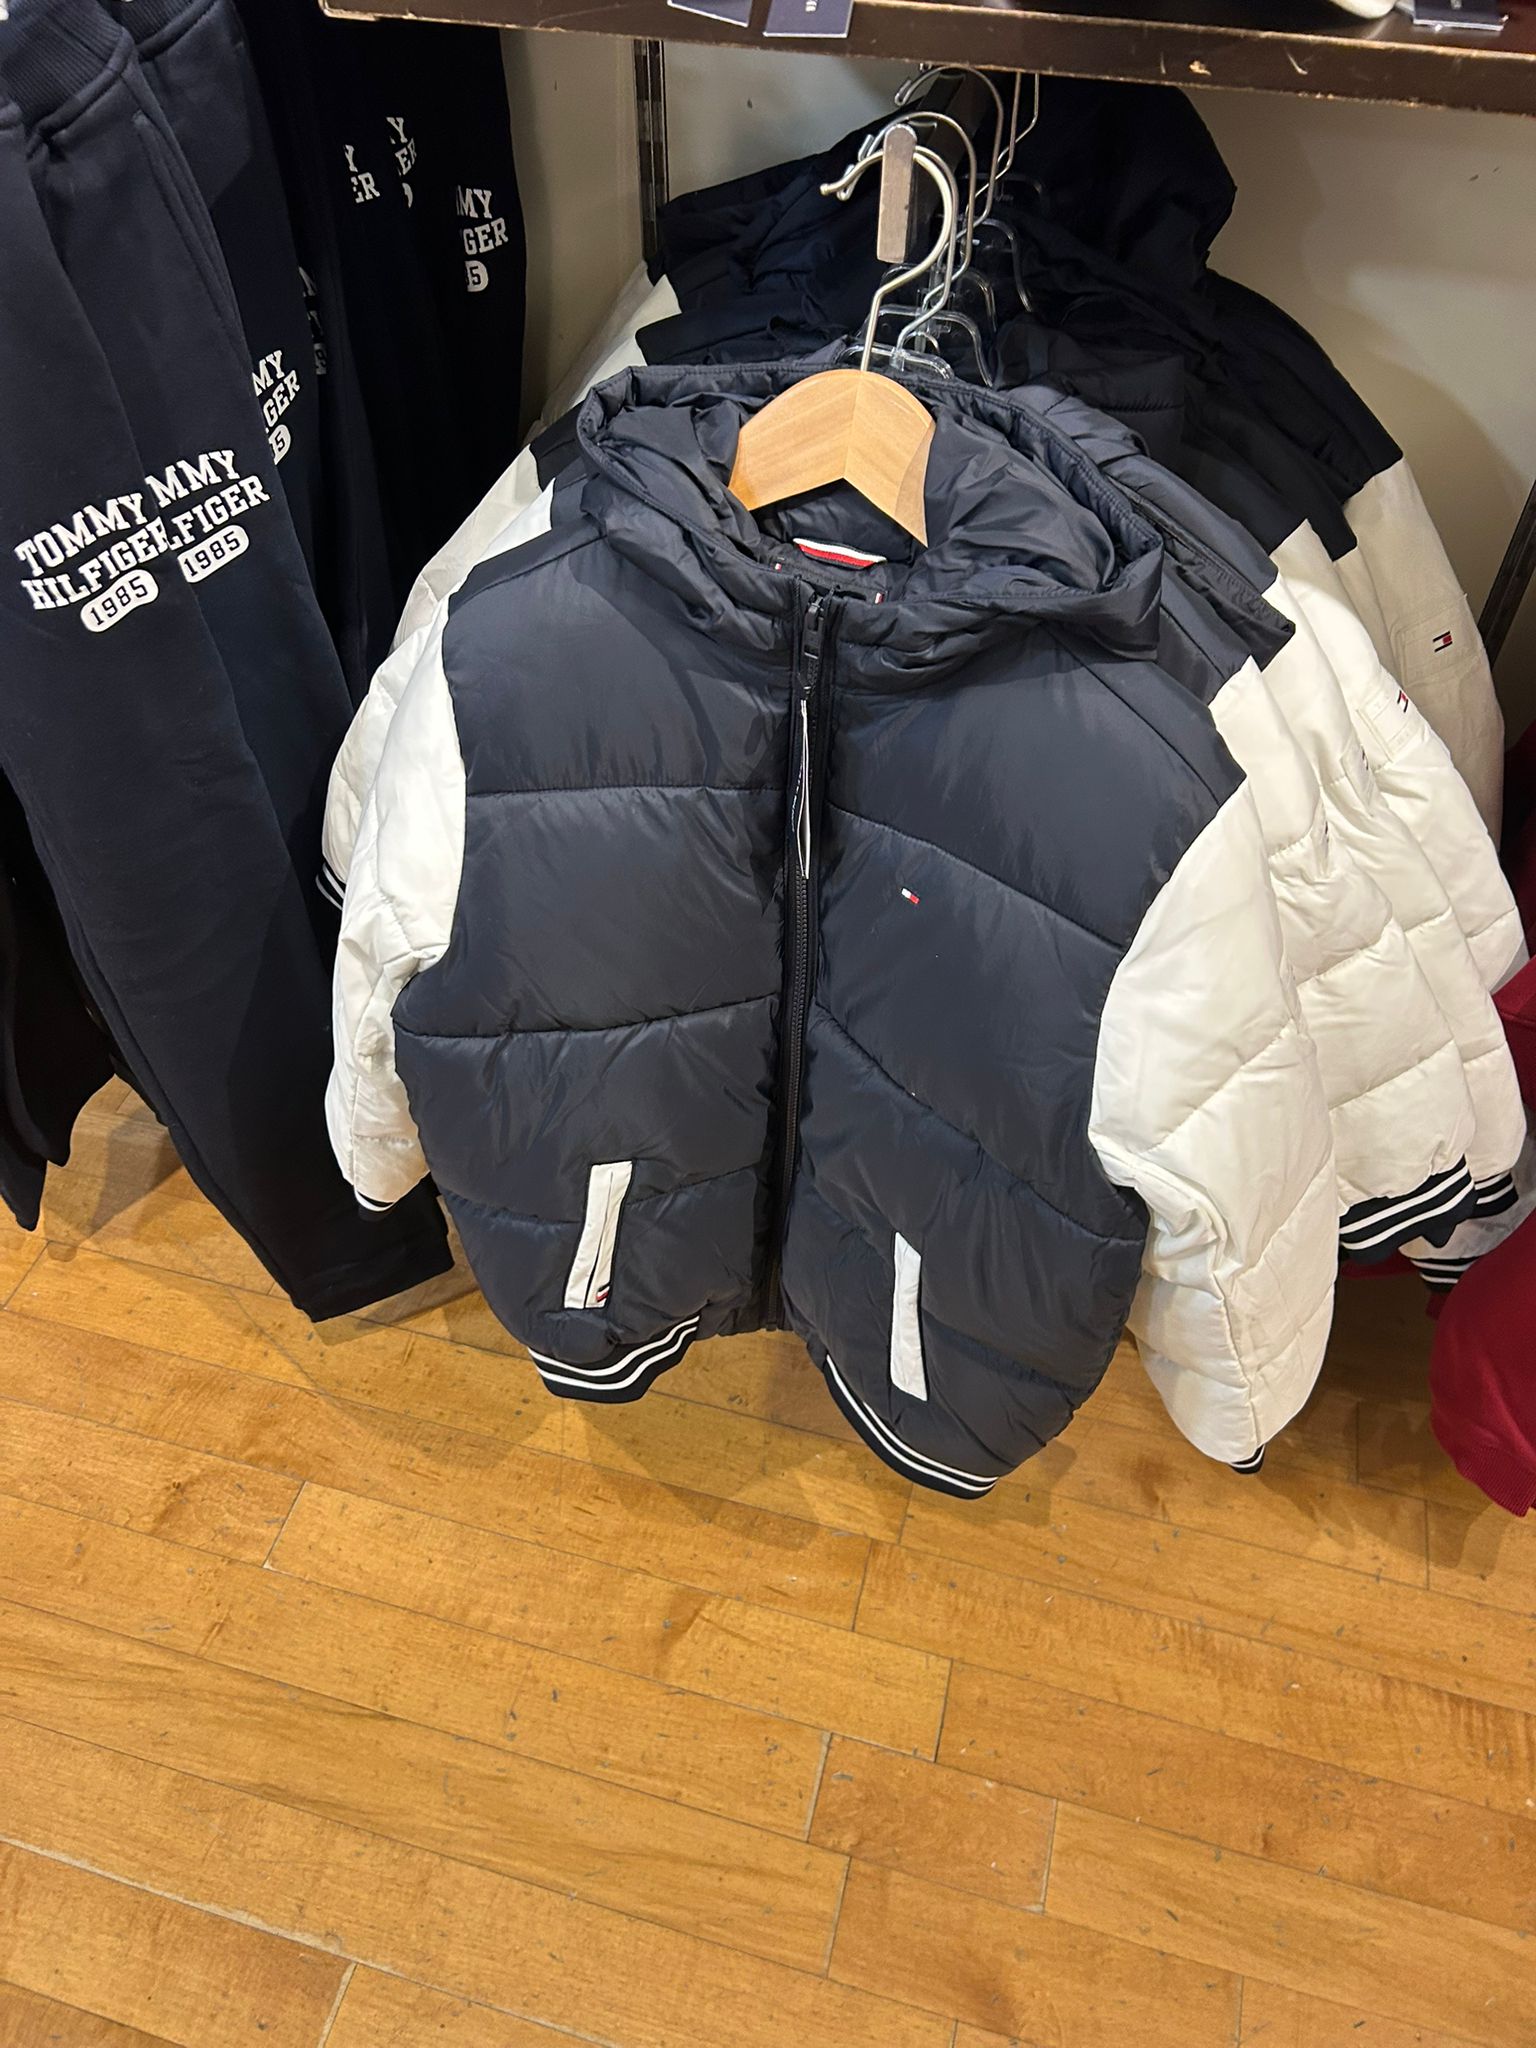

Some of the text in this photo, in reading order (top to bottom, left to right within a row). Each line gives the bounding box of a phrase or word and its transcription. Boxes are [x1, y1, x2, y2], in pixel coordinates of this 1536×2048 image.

[14, 492, 148, 578] TOMMY
[21, 516, 170, 610] HILFIGER
[182, 529, 242, 577] 1985
[88, 573, 150, 627] 1985
